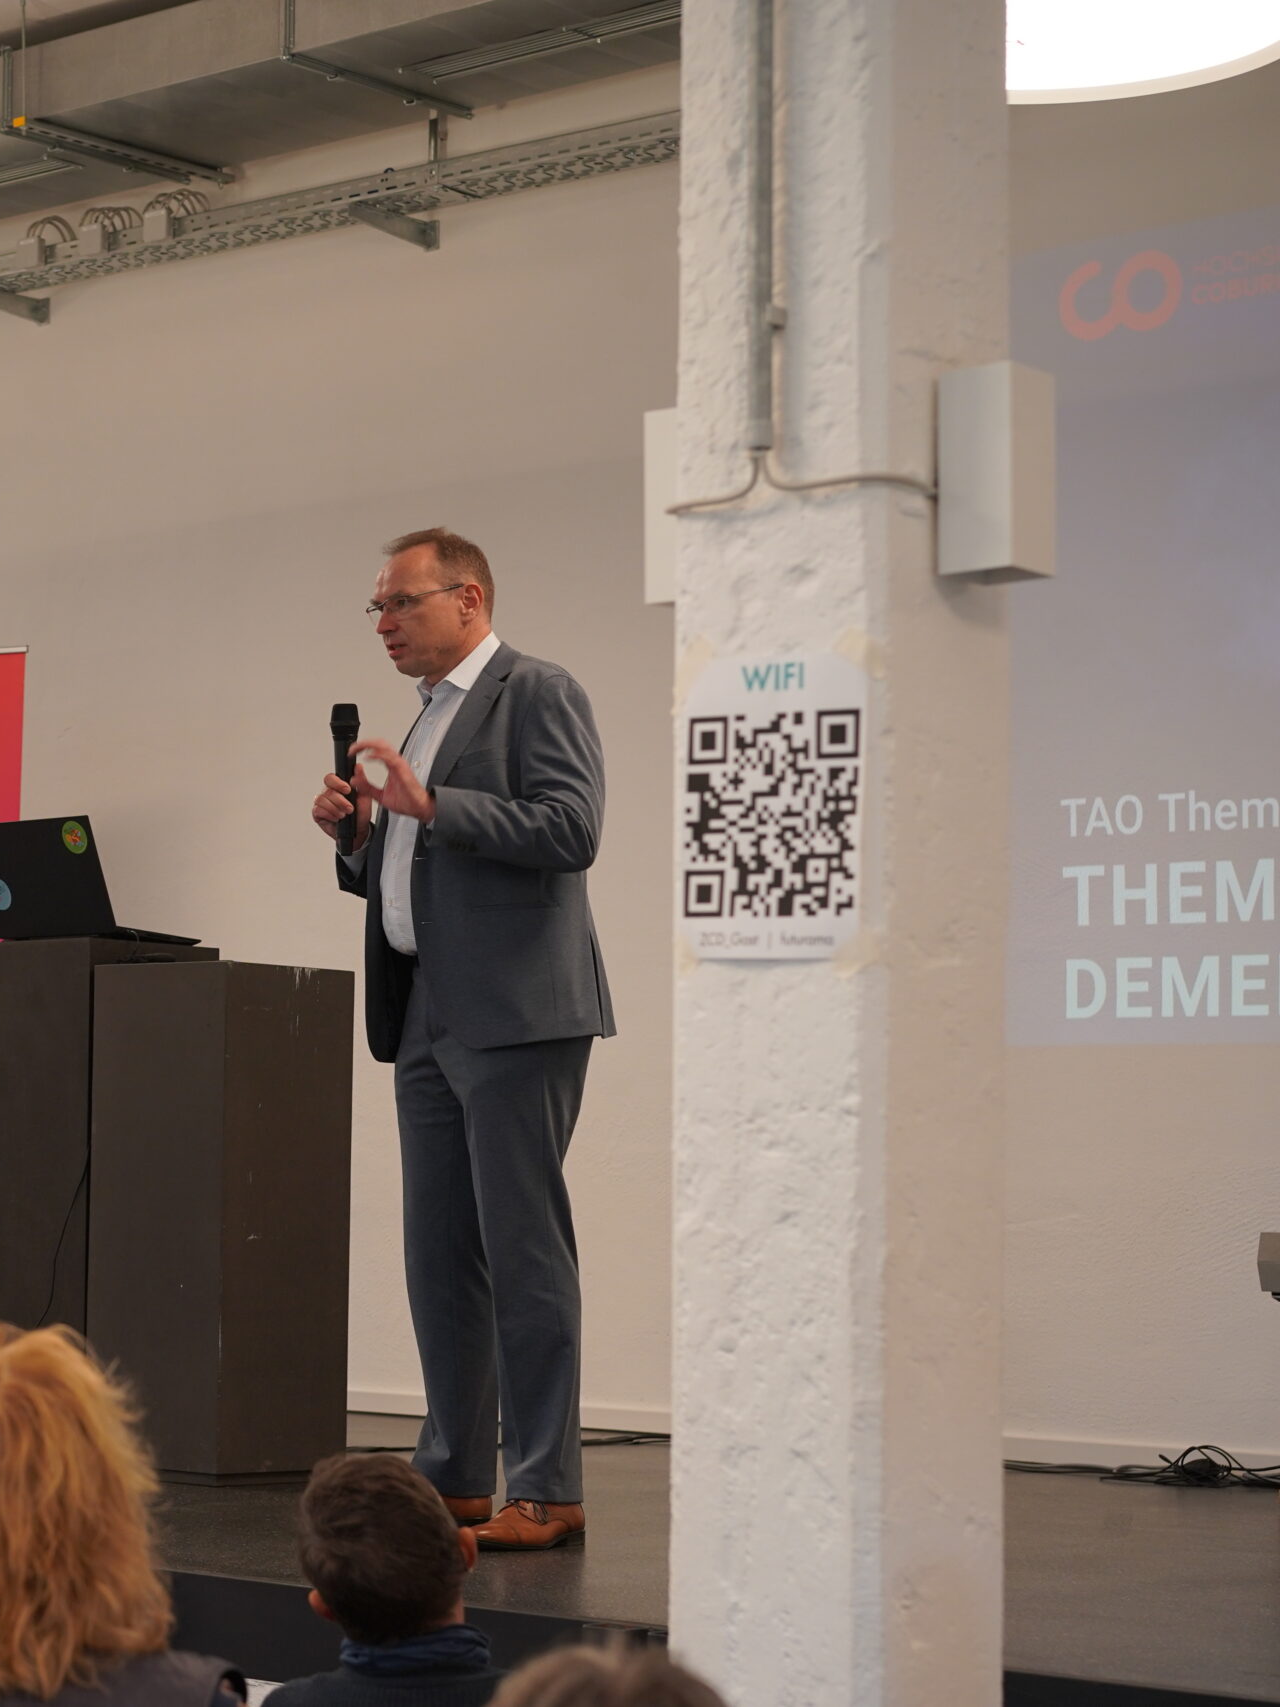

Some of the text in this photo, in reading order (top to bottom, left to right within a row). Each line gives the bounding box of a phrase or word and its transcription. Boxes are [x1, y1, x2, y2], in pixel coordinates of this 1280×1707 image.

[742, 662, 804, 691] WIFI
[1060, 794, 1144, 837] TAO
[1062, 857, 1275, 927] THEM
[1065, 954, 1280, 1019] DEME
